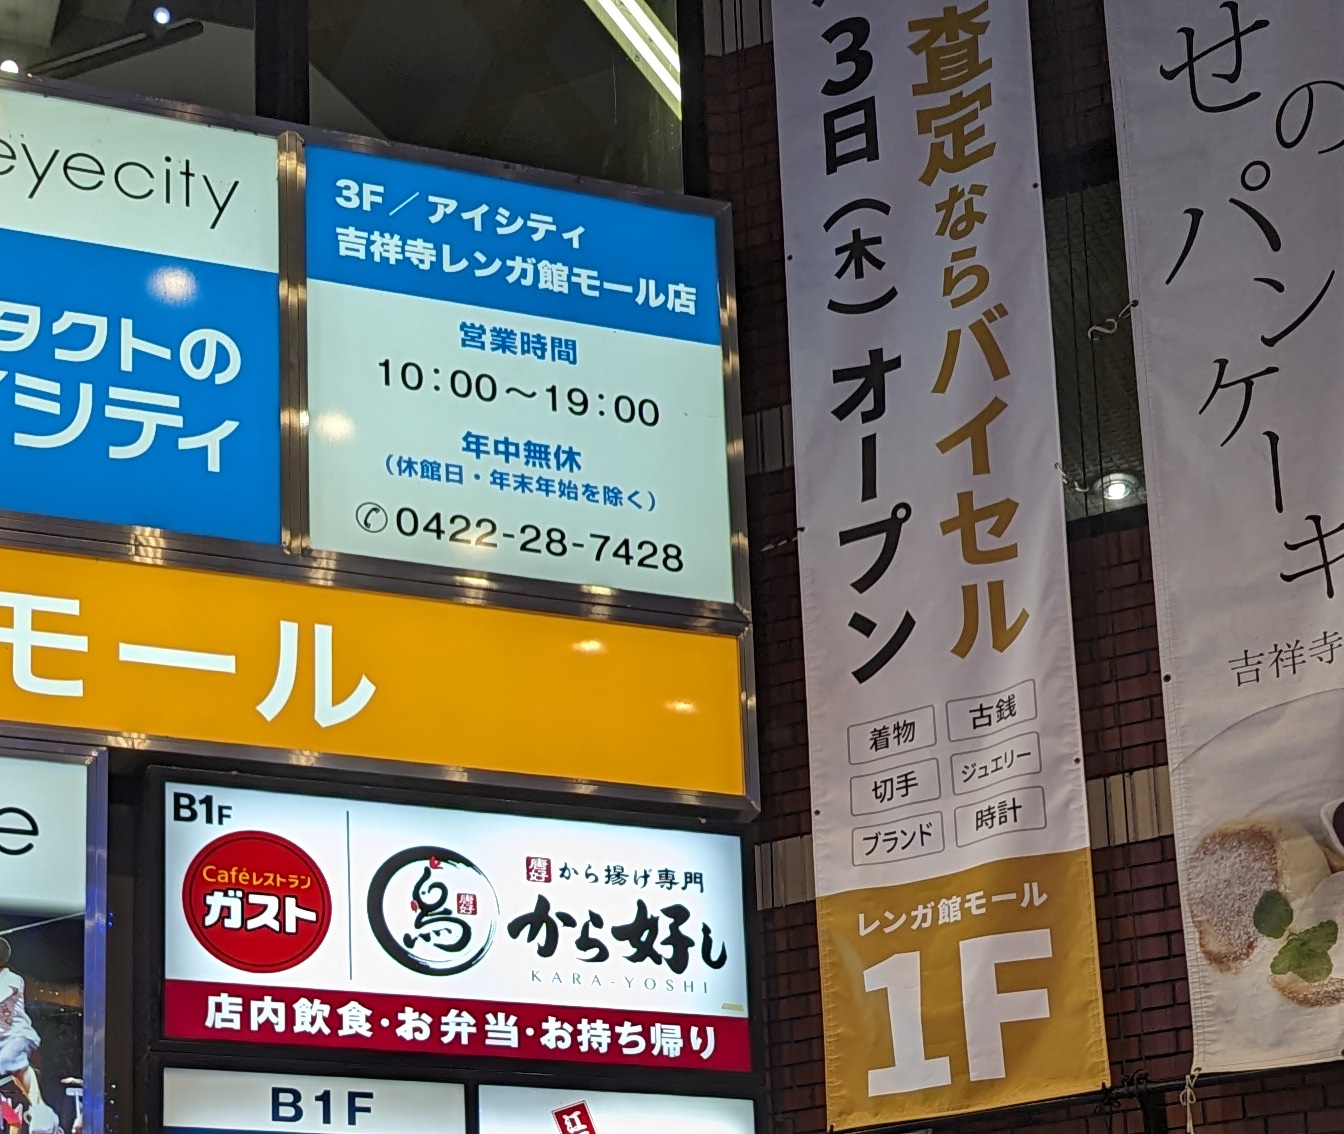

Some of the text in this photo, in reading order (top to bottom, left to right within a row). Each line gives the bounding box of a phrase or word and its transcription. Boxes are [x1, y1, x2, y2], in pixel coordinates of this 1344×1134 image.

[335, 226, 698, 316] 吉祥寺レンガ館モール店
[459, 321, 578, 365] 営業時間
[907, 0, 1030, 659] 査定ならバイセル
[461, 431, 583, 472] 年中無休
[395, 507, 684, 573] 0422-28-7428
[868, 694, 1017, 752] 着物 古銭
[871, 749, 1032, 803] 切手 ジュエリー
[172, 792, 233, 826] B1F
[862, 797, 1022, 857] ブランド 時計
[202, 863, 312, 890] Caféレストラン
[559, 861, 705, 893] から揚げ専門
[203, 889, 318, 935] ガスト
[506, 893, 728, 975] から好し
[857, 882, 1048, 938] レンガ館モール
[531, 968, 709, 994] KARA-YOSHI
[204, 993, 717, 1061] 店内飲食・お弁当・お持ち帰り
[862, 928, 1053, 1097] 1F
[270, 1085, 375, 1126] B1F
